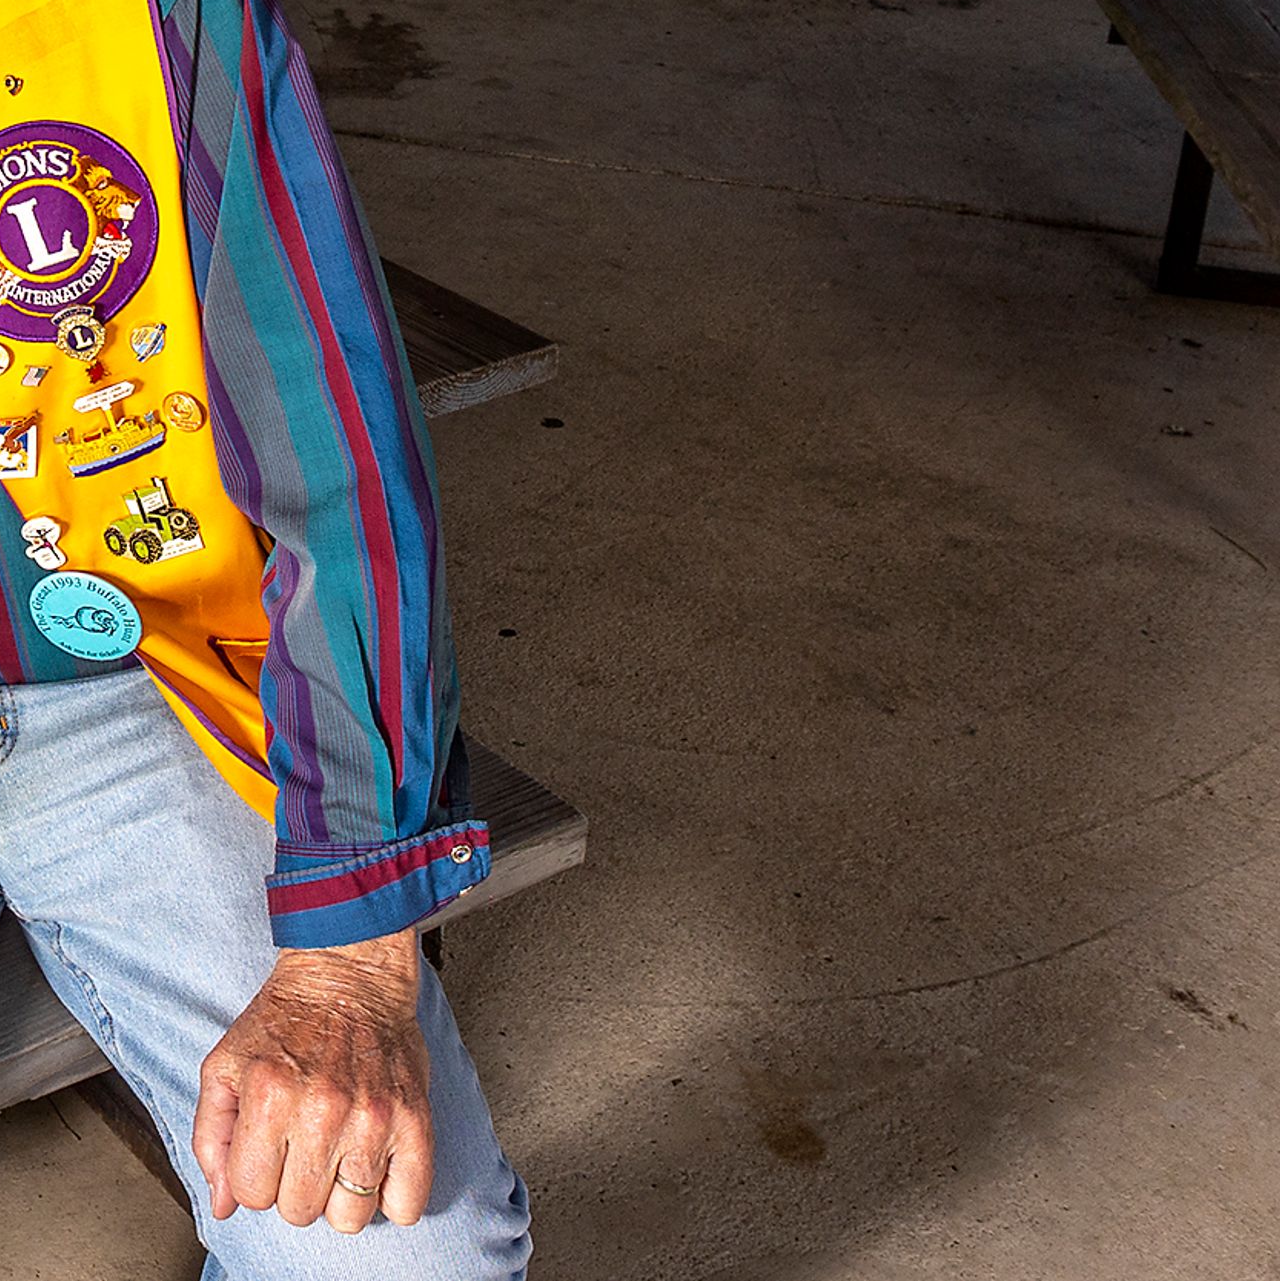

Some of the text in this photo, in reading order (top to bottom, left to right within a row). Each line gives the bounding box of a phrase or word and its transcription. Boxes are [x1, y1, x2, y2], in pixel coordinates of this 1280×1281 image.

[6, 197, 80, 273] L
[7, 249, 116, 306] INTERNATIONAL
[72, 328, 94, 349] L
[32, 585, 52, 611] Great
[50, 577, 83, 591] 1993
[86, 580, 129, 617] Buffalo
